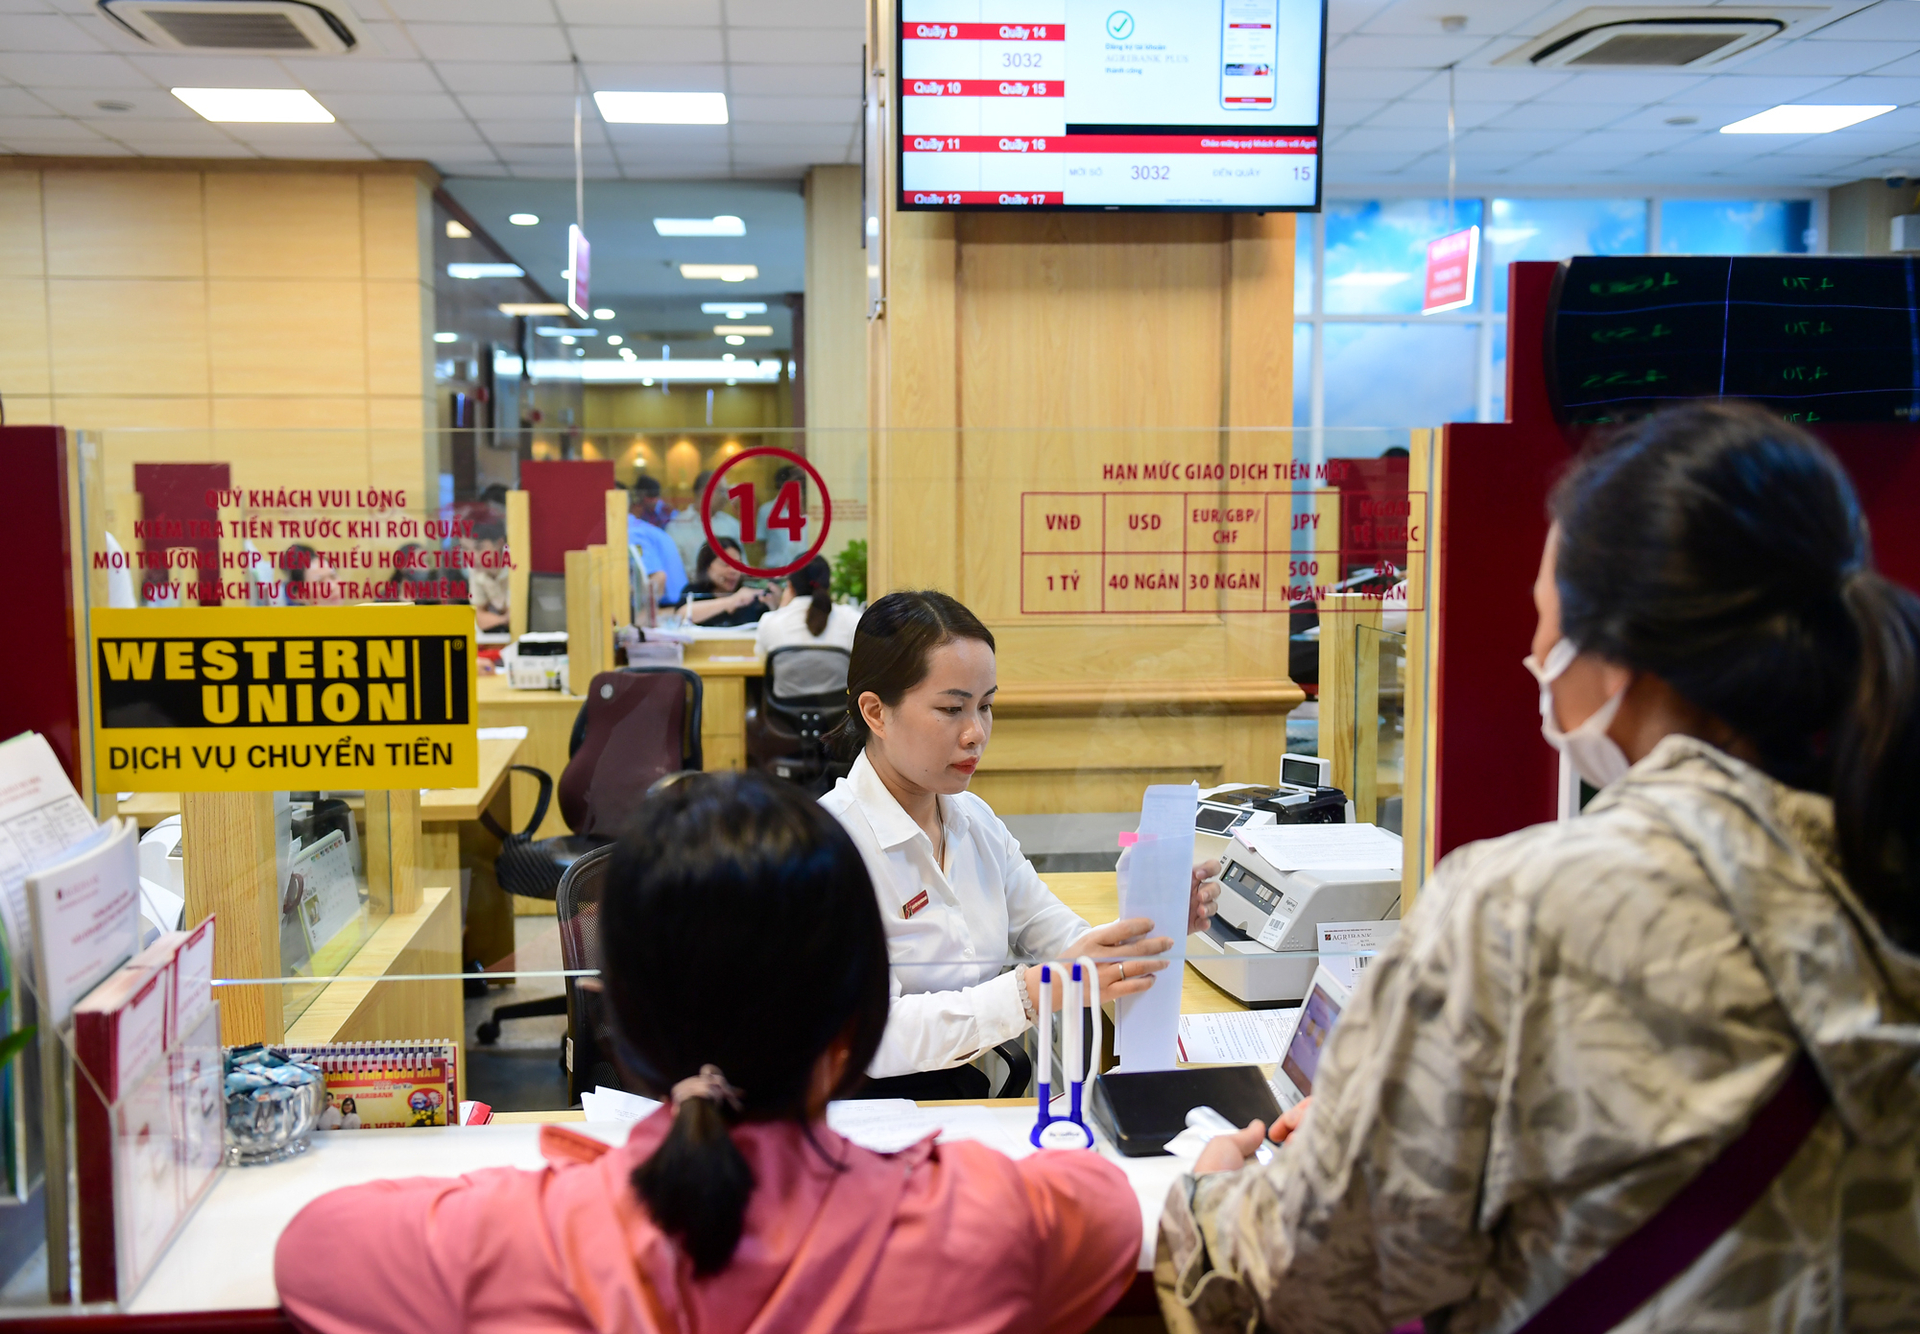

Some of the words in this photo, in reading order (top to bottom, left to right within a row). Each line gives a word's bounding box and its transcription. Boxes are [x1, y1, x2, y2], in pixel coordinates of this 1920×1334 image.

[916, 25, 947, 40] Quầy
[949, 25, 958, 38] 9
[999, 26, 1030, 40] Quầy
[1032, 26, 1047, 39] 14
[1003, 53, 1042, 68] 3032
[914, 82, 945, 96] Quầy
[947, 82, 962, 94] 10
[999, 83, 1030, 97] Quầy
[1032, 83, 1047, 95] 15
[914, 138, 945, 152] Quầy
[947, 138, 960, 150] 11
[999, 138, 1030, 152] Quầy
[1031, 138, 1046, 151] 16
[1131, 165, 1170, 180] 3032
[1293, 166, 1311, 181] 15
[947, 194, 962, 205] 12
[1031, 194, 1046, 205] 17
[1102, 464, 1138, 485] HẠN
[1143, 460, 1181, 480] MỨC
[1185, 464, 1225, 480] GIAO
[1229, 464, 1268, 485] DỊCH
[205, 486, 243, 510] QUÝ
[250, 486, 312, 508] KHÁCH
[318, 490, 351, 508] VUI
[728, 481, 807, 543] 14
[1192, 508, 1261, 524] EUR/GBP/
[134, 512, 184, 538] KIỂM
[188, 520, 225, 538] TRA
[278, 518, 342, 539] TRƯỚC
[348, 520, 380, 539] KHI
[387, 517, 419, 539] RỜI
[1045, 514, 1081, 531] VNĐ
[1129, 514, 1162, 531] USD
[1291, 513, 1321, 531] JPY
[1213, 530, 1239, 545] CHF
[93, 551, 130, 573] MỌI
[136, 547, 217, 569] TRƯỜNG
[222, 550, 262, 574] HỢP
[317, 545, 372, 569] THIẾU
[379, 546, 428, 574] HOẶC
[1288, 561, 1319, 577] 500
[1373, 560, 1394, 578] 40
[1046, 575, 1054, 591] 1
[1108, 574, 1129, 590] 40
[1189, 574, 1209, 590] 30
[142, 578, 181, 602] QUÝ
[187, 578, 250, 599] KHÁCH
[256, 580, 282, 605] TỰ
[285, 581, 336, 605] CHỊU
[338, 578, 399, 599] TRÁCH
[101, 639, 407, 681] WESTERN
[202, 682, 408, 724] UNION
[109, 746, 182, 774] DỊCH
[192, 745, 236, 772] VỤ
[247, 736, 375, 768] CHUYỂN
[385, 737, 453, 766] TIỀN
